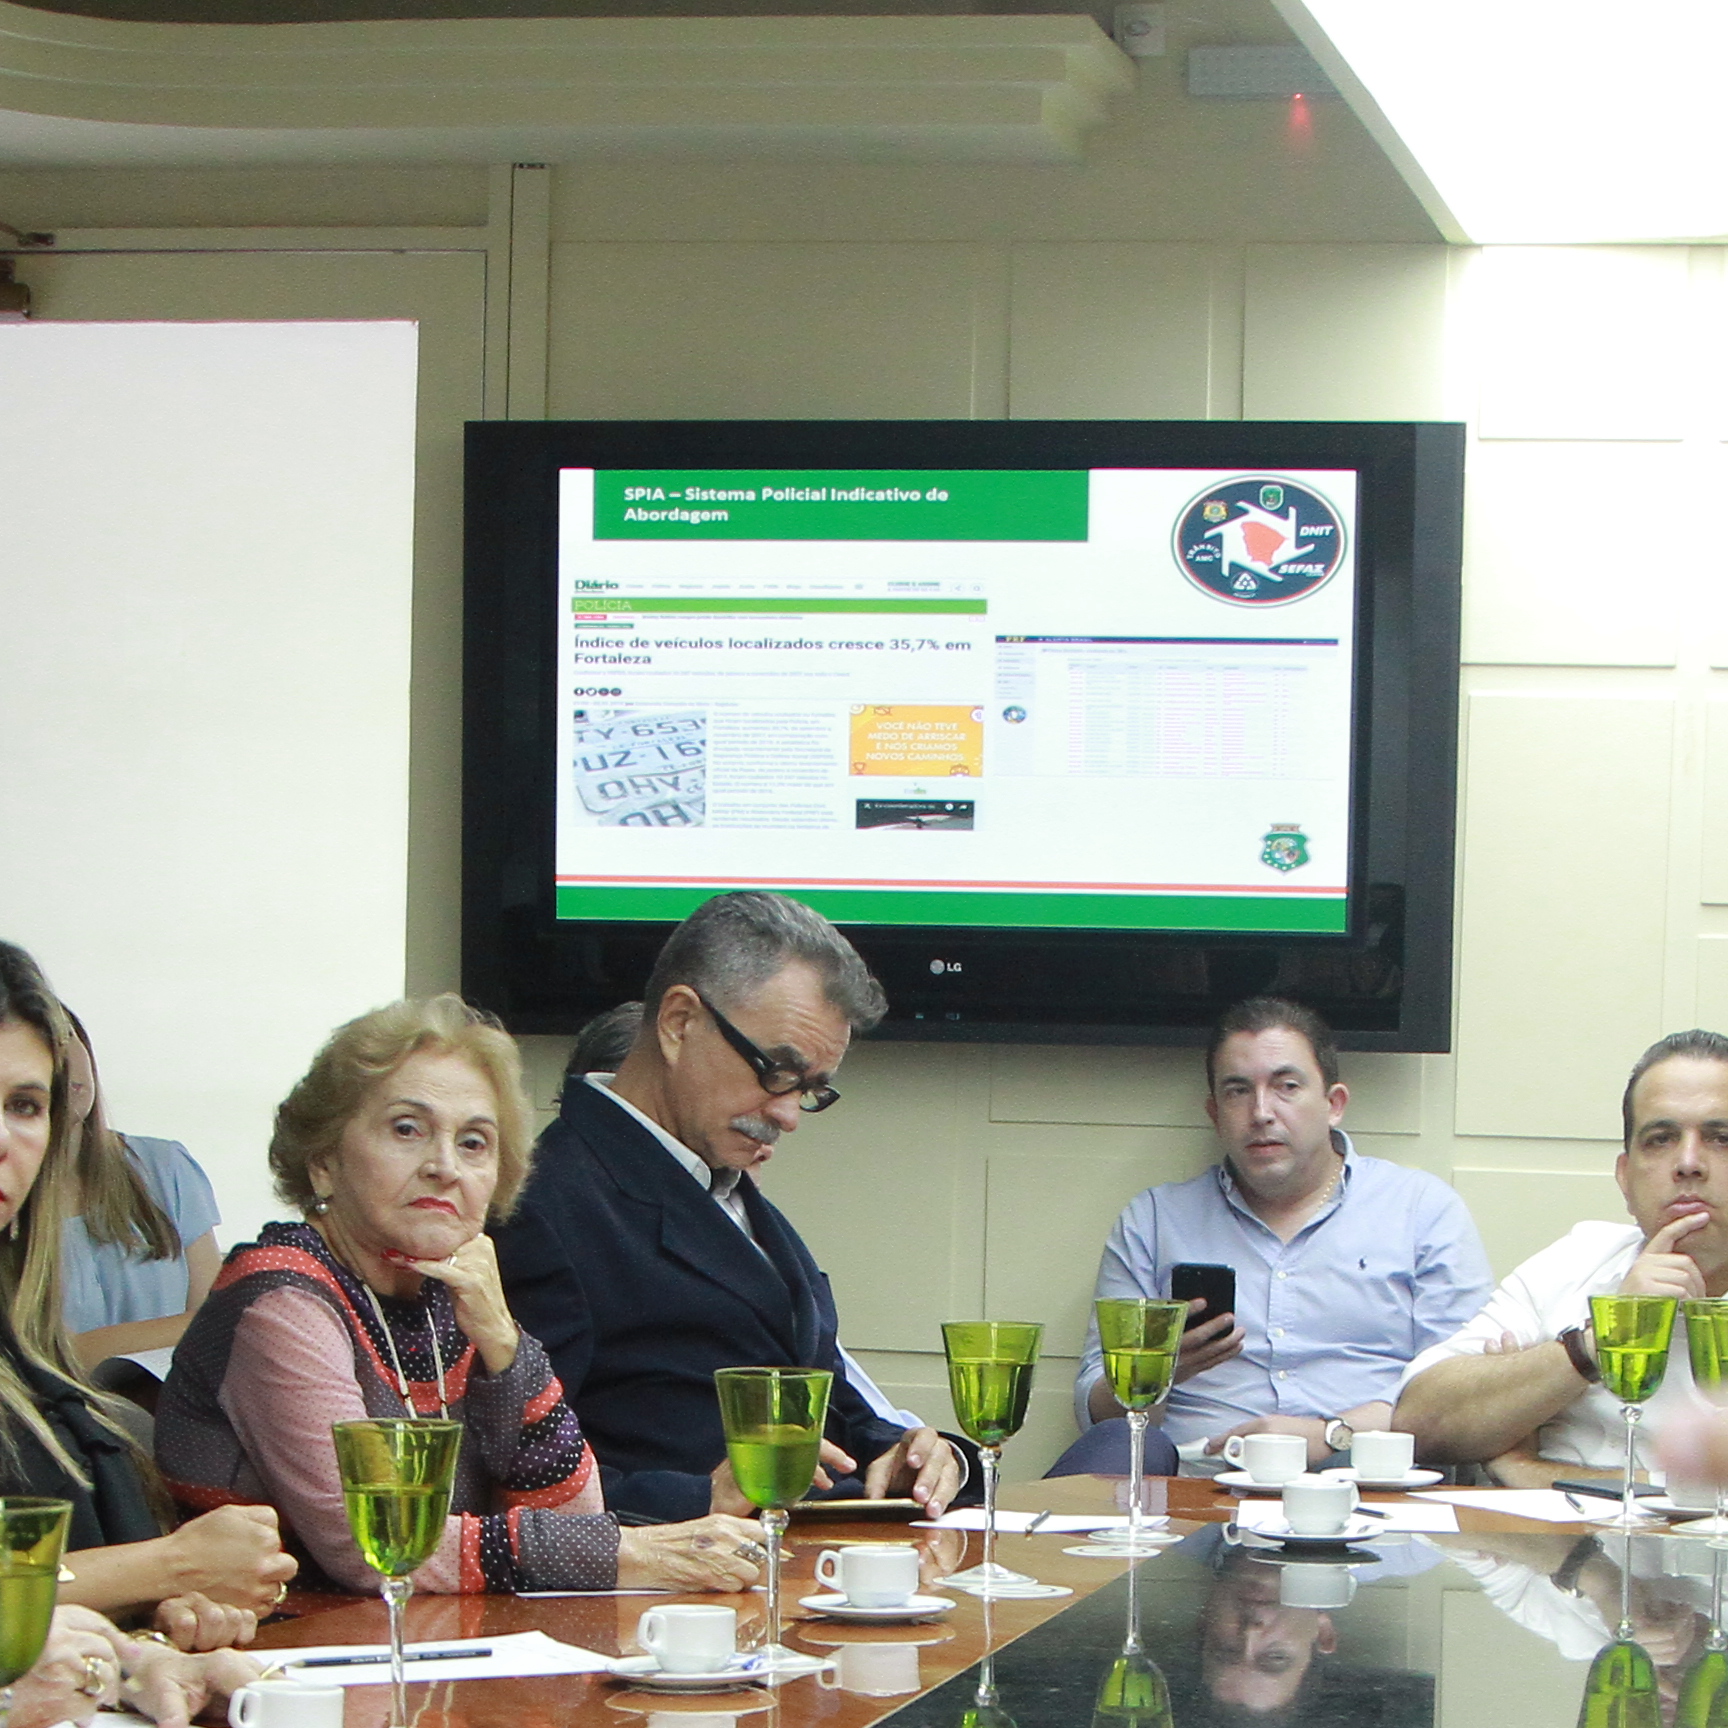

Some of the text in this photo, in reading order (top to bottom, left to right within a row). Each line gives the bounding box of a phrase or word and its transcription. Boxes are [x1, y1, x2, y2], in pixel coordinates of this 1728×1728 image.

[624, 487, 665, 501] SPIA
[685, 486, 756, 502] Sistema
[762, 486, 827, 502] Policial
[830, 487, 921, 502] Indicativo
[925, 488, 950, 502] de
[623, 507, 730, 524] Abordagem
[1299, 525, 1335, 538] DNIT
[1278, 563, 1326, 575] SEFAZ
[574, 579, 620, 591] Diário
[574, 599, 632, 611] POLÍCIA
[574, 634, 972, 653] Índice de veículos localizados cresce 35,7% em
[574, 652, 652, 665] Fortaleza
[935, 722, 958, 731] TEVE
[867, 732, 967, 742] MEDO DE ARRISCAR
[910, 742, 958, 751] CRIAMOS
[866, 752, 905, 761] NOVOS
[946, 962, 962, 972] LG
